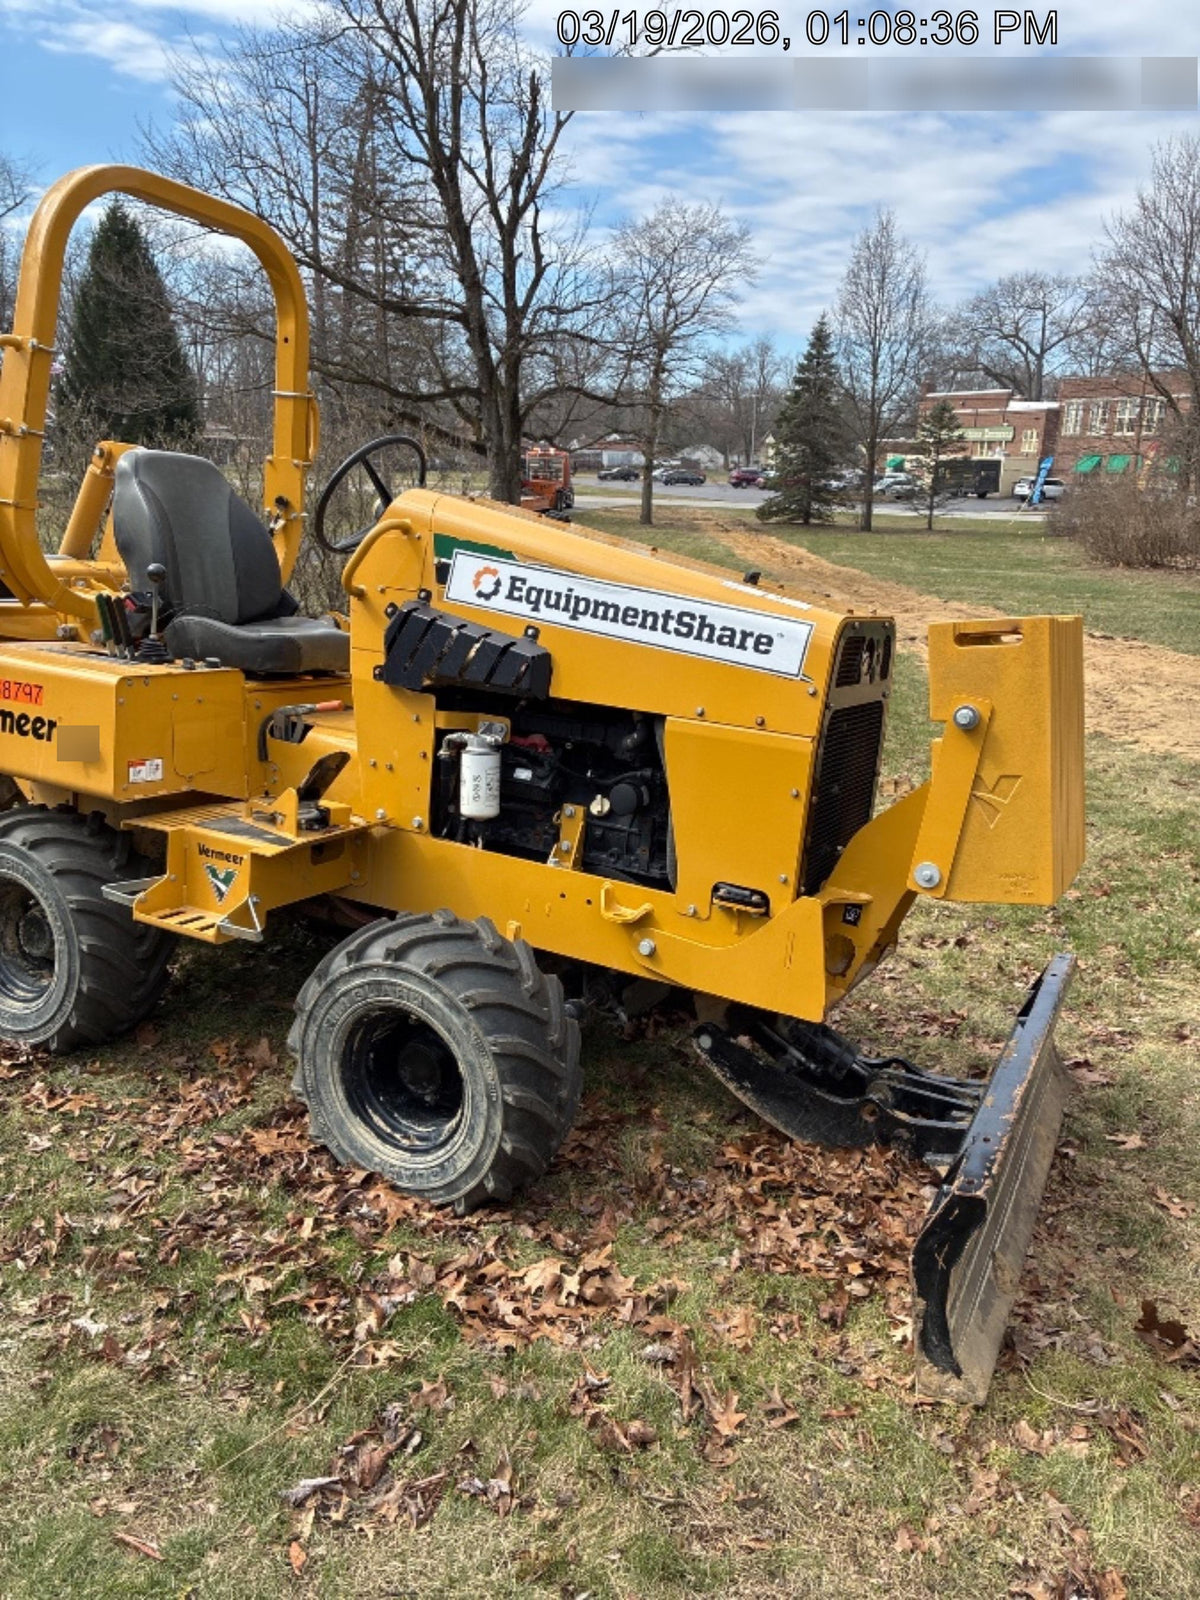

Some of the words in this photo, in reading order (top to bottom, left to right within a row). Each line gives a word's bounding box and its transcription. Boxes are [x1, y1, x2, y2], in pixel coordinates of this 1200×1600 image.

[505, 575, 775, 655] EquipmentShare
[0, 680, 44, 704] 8797
[0, 709, 57, 742] meer
[197, 842, 244, 866] Vermeer
